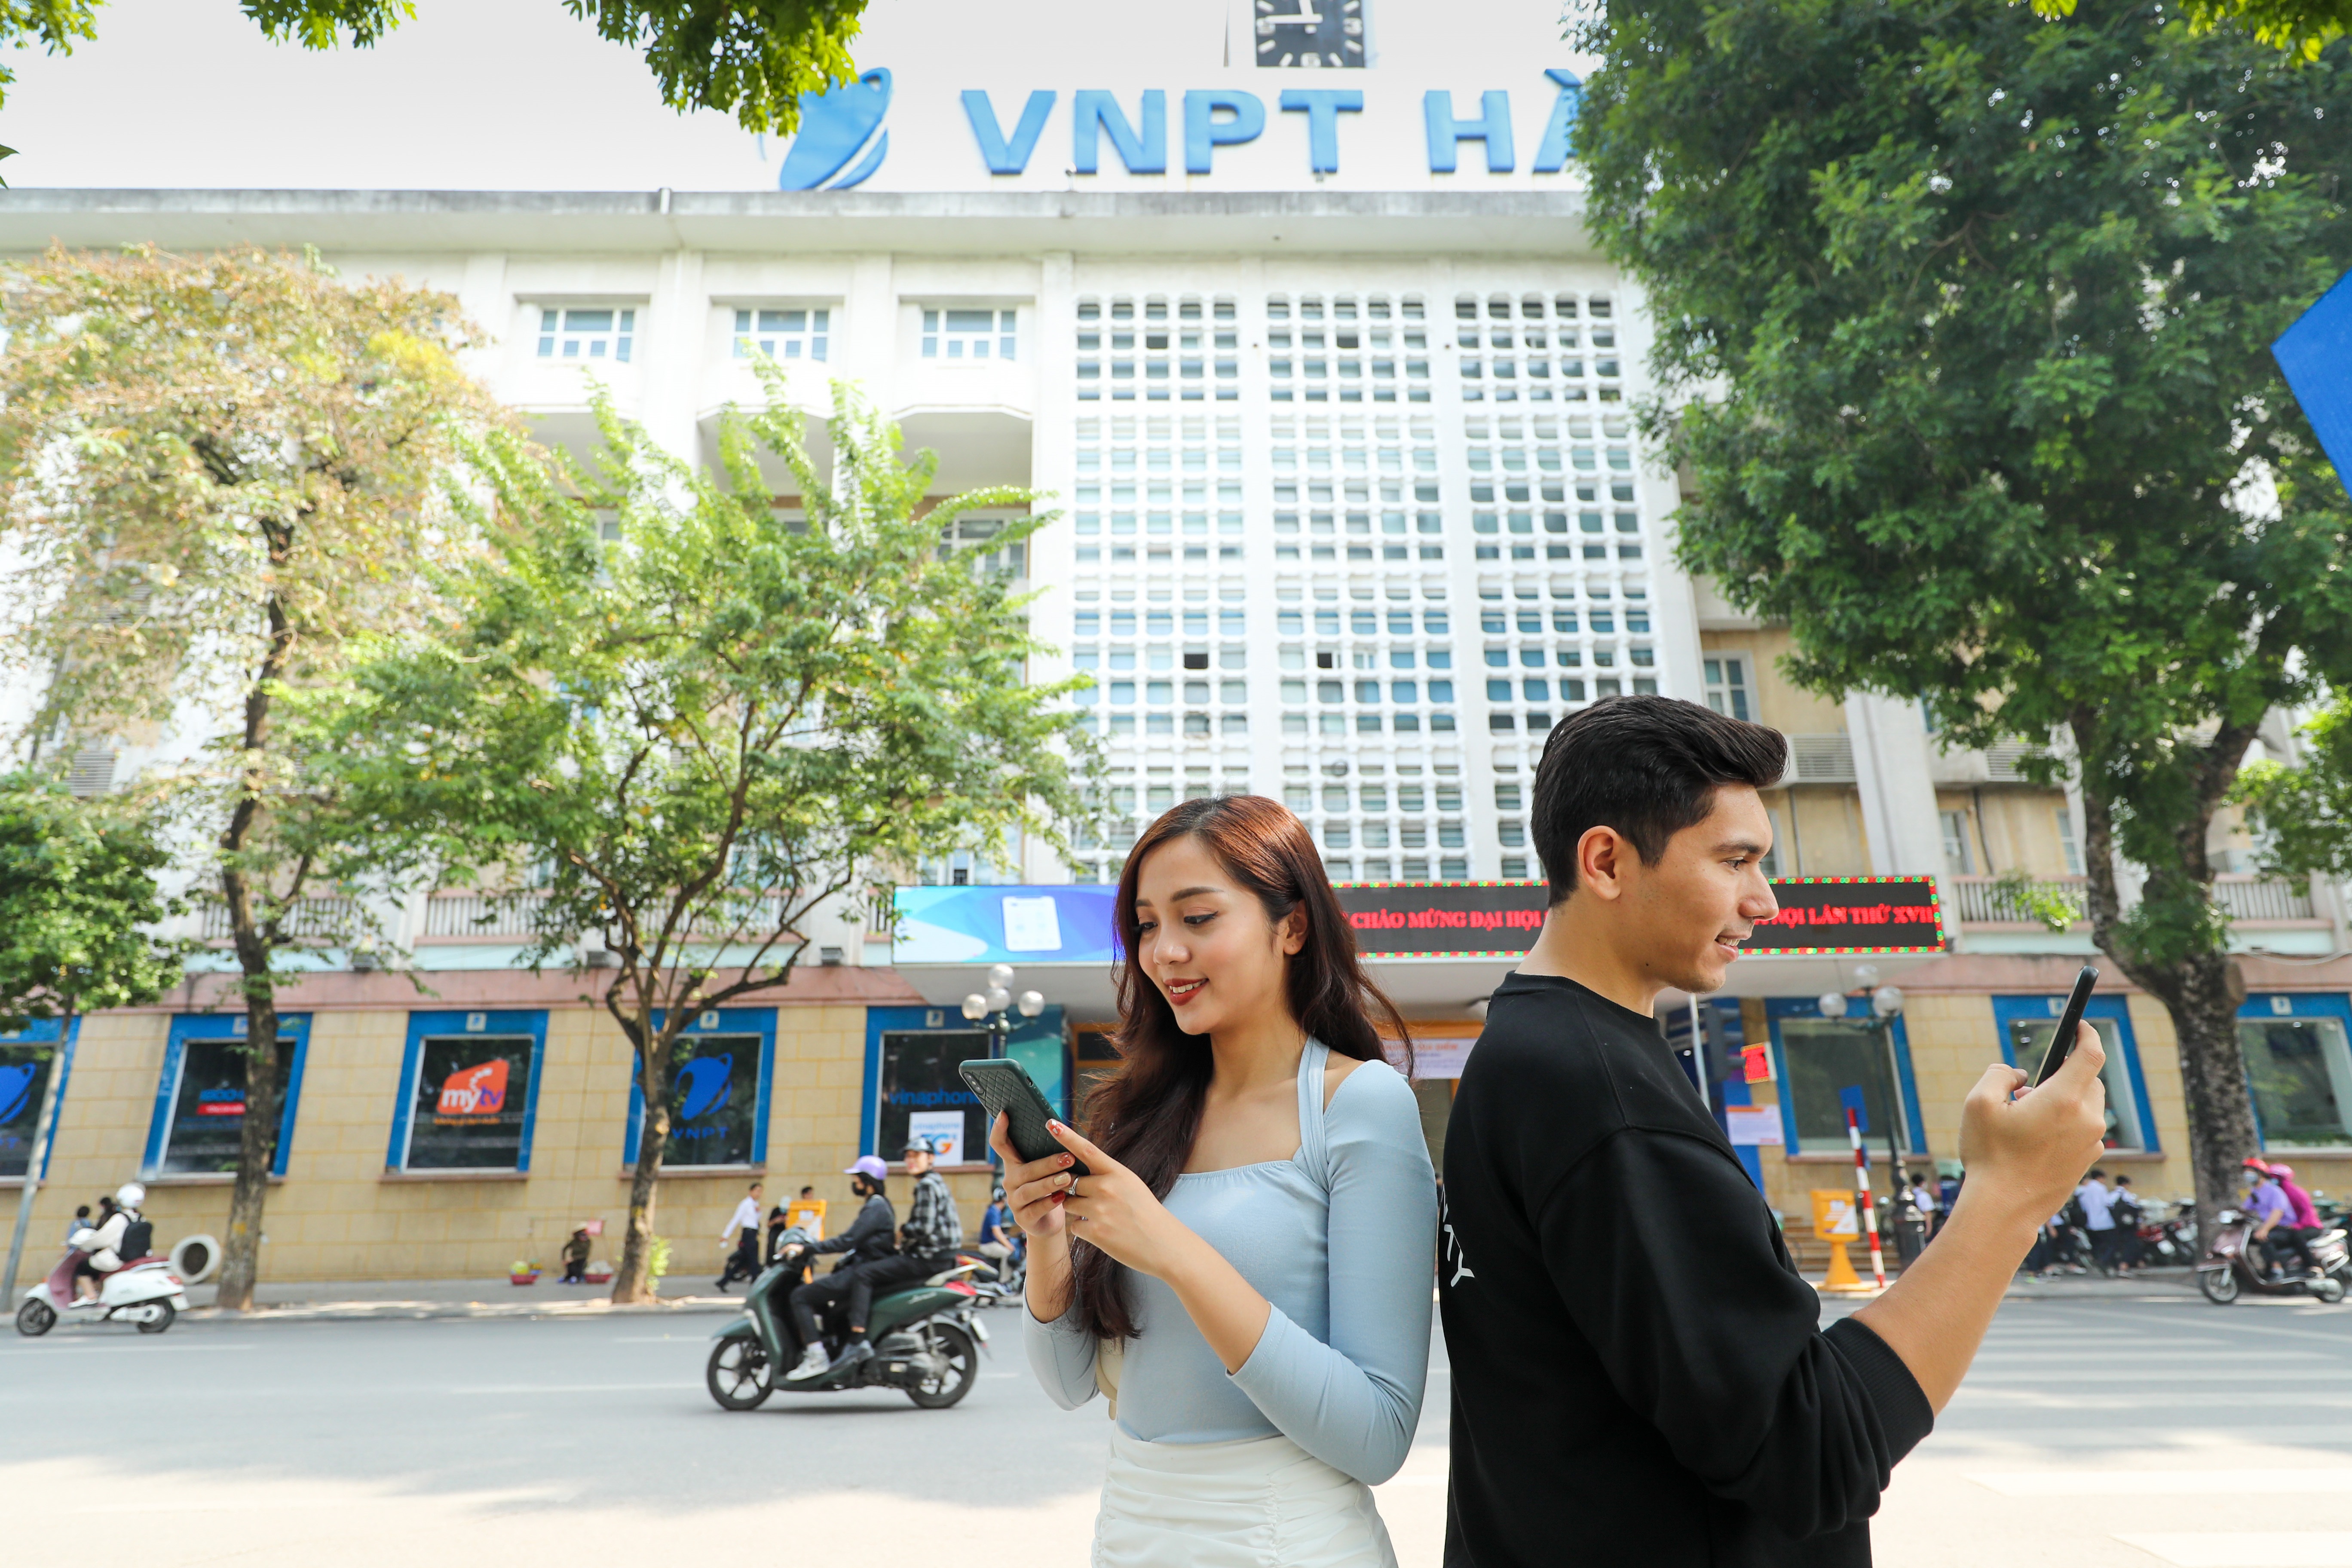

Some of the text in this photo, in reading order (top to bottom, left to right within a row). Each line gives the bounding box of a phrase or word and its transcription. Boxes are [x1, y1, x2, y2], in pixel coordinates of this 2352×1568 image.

[960, 89, 1363, 175] VNPT
[441, 1075, 503, 1113] mytv
[671, 1126, 729, 1139] VNPT
[921, 1133, 952, 1155] G
